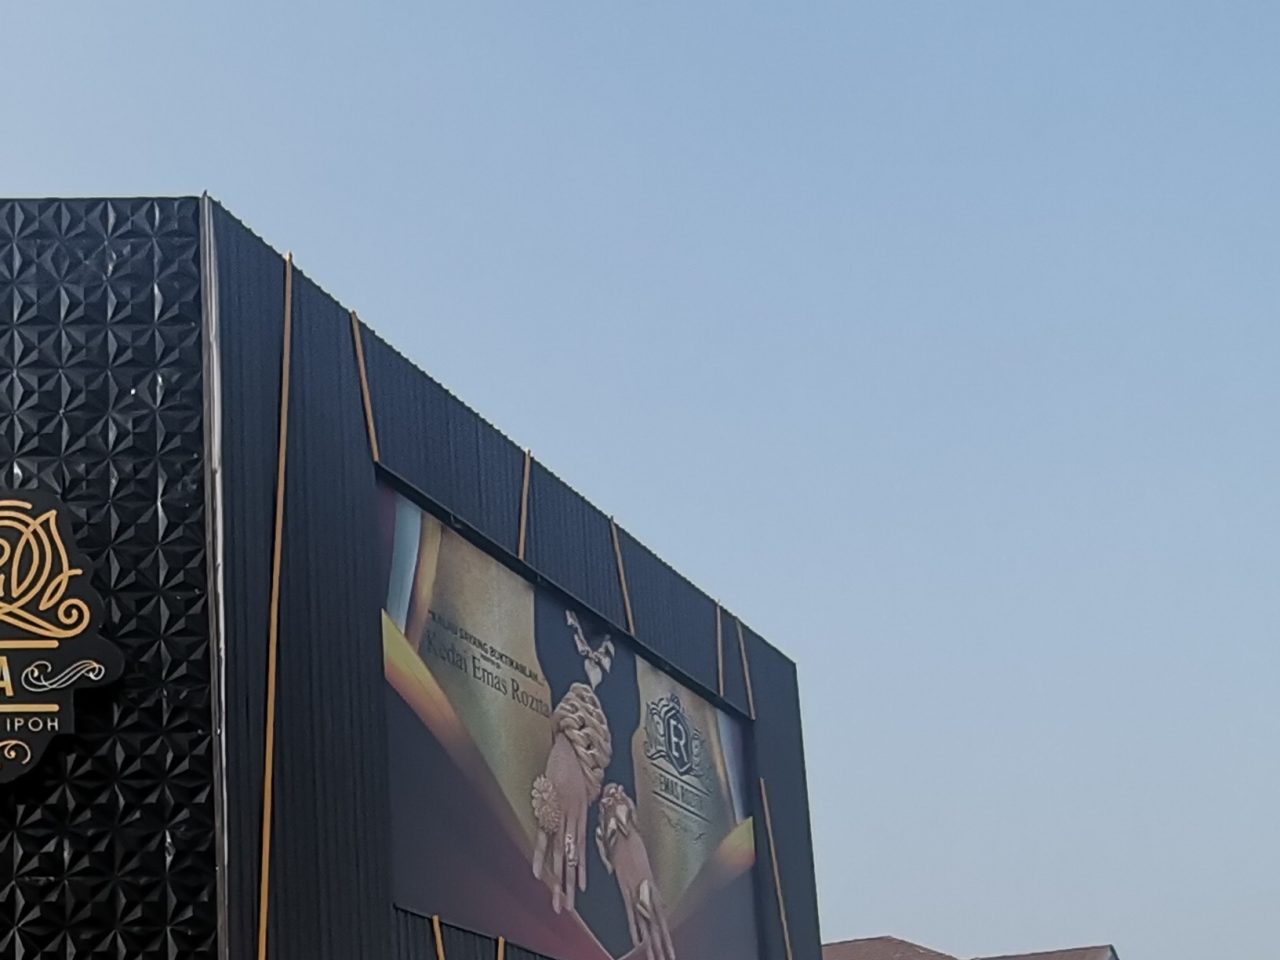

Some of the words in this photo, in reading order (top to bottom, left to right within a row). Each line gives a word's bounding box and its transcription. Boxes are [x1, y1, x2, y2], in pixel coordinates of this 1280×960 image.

[472, 655, 508, 696] Emas
[510, 678, 551, 718] Rozita
[6, 716, 60, 732] IPOH
